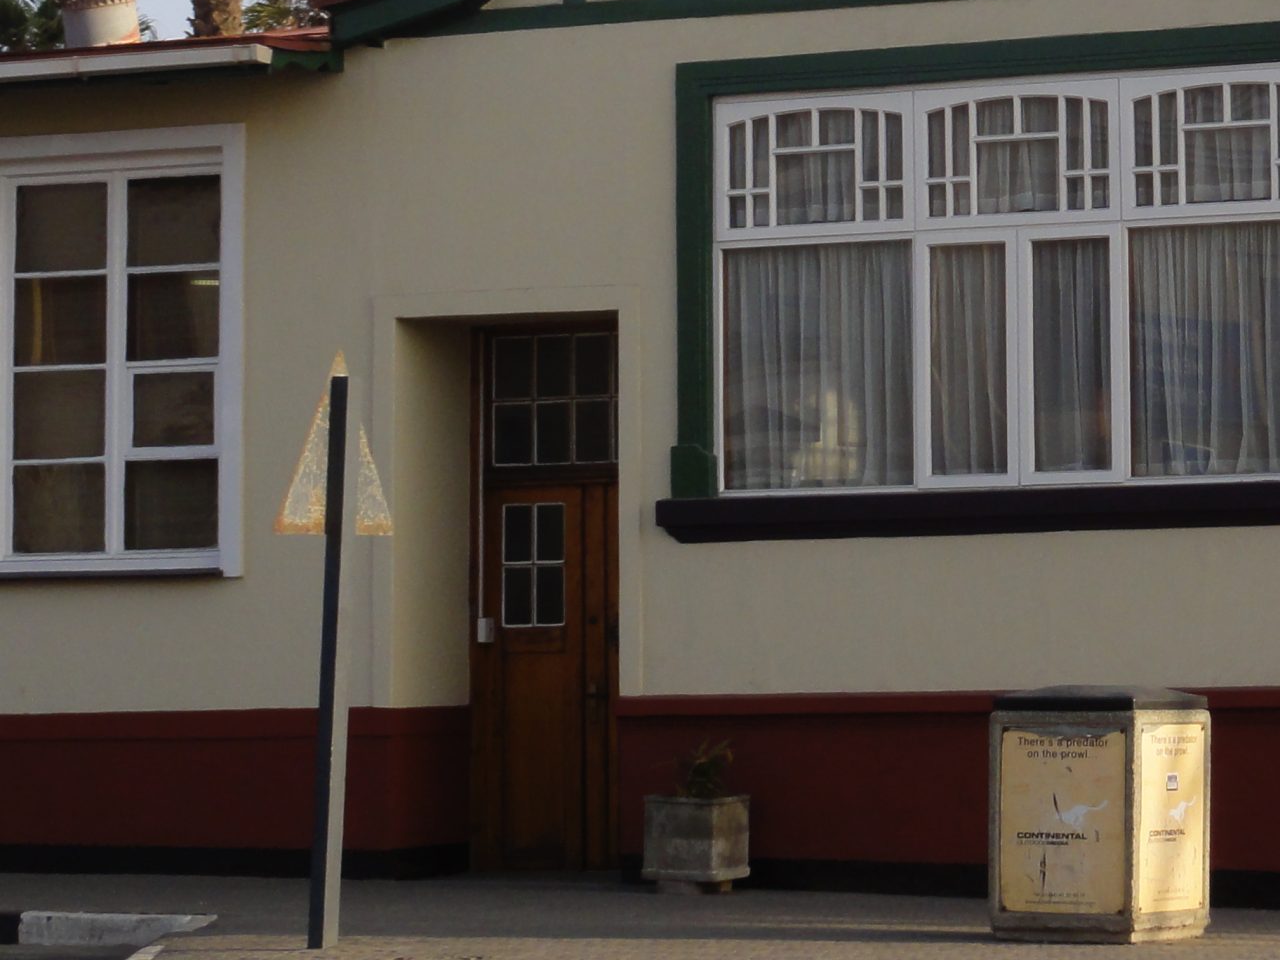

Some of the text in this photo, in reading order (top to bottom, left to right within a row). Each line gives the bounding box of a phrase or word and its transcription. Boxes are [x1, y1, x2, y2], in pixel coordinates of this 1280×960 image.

[1017, 736, 1054, 747] Theres
[1066, 736, 1108, 748] predator
[1027, 750, 1039, 759] on
[1042, 749, 1058, 759] the
[1016, 831, 1088, 840] CONTINENTAL
[1148, 828, 1186, 837] CONTINENTAL
